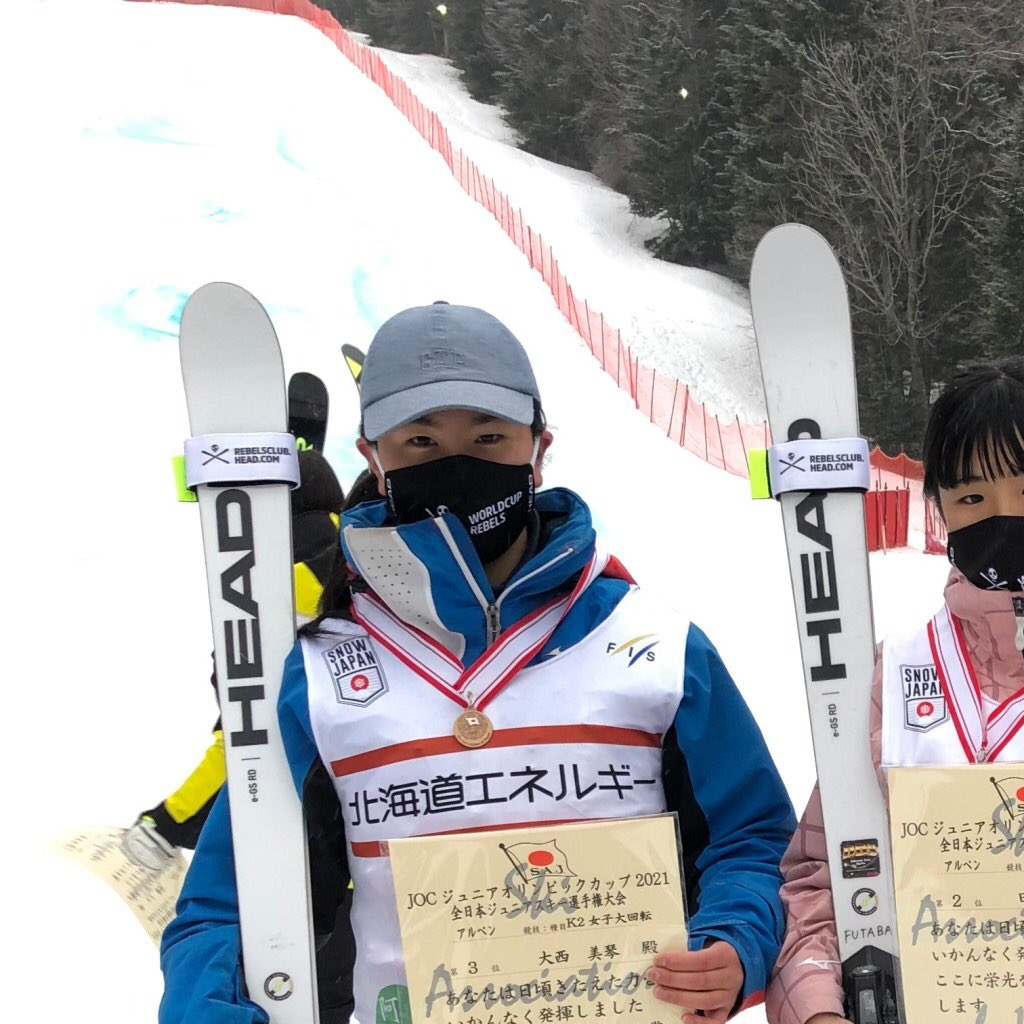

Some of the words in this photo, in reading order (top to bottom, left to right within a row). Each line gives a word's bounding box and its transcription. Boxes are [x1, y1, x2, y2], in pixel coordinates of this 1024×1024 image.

[234, 447, 292, 456] REBELSCLUB.
[235, 456, 280, 464] HEAD.COM
[810, 454, 865, 463] REBELSCLUB.
[811, 463, 854, 472] HEAD.COM
[468, 491, 523, 525] WORLDCUP
[470, 512, 506, 535] REBELS
[216, 489, 268, 747] HEAD
[327, 639, 367, 663] SNOW
[334, 651, 376, 676] JAPAN
[349, 763, 656, 826] 北海道エネルギー
[900, 822, 928, 838] JOC
[944, 859, 981, 872] アルペン
[407, 892, 437, 909] JOC
[442, 873, 631, 904] ジュニアオリンピックカップ
[635, 872, 670, 887] 2021
[952, 894, 962, 908] 2
[451, 891, 627, 921] 全日本ジュニアスキー選手権大会
[457, 925, 496, 940] アルペン
[566, 917, 585, 929] K2
[588, 911, 652, 926] 女子大回転
[844, 925, 893, 943] FUTABA
[468, 961, 478, 975] 3
[539, 949, 569, 966] 大西
[588, 944, 620, 961] 美琴
[642, 940, 660, 955] 殿
[939, 998, 984, 1013] します
